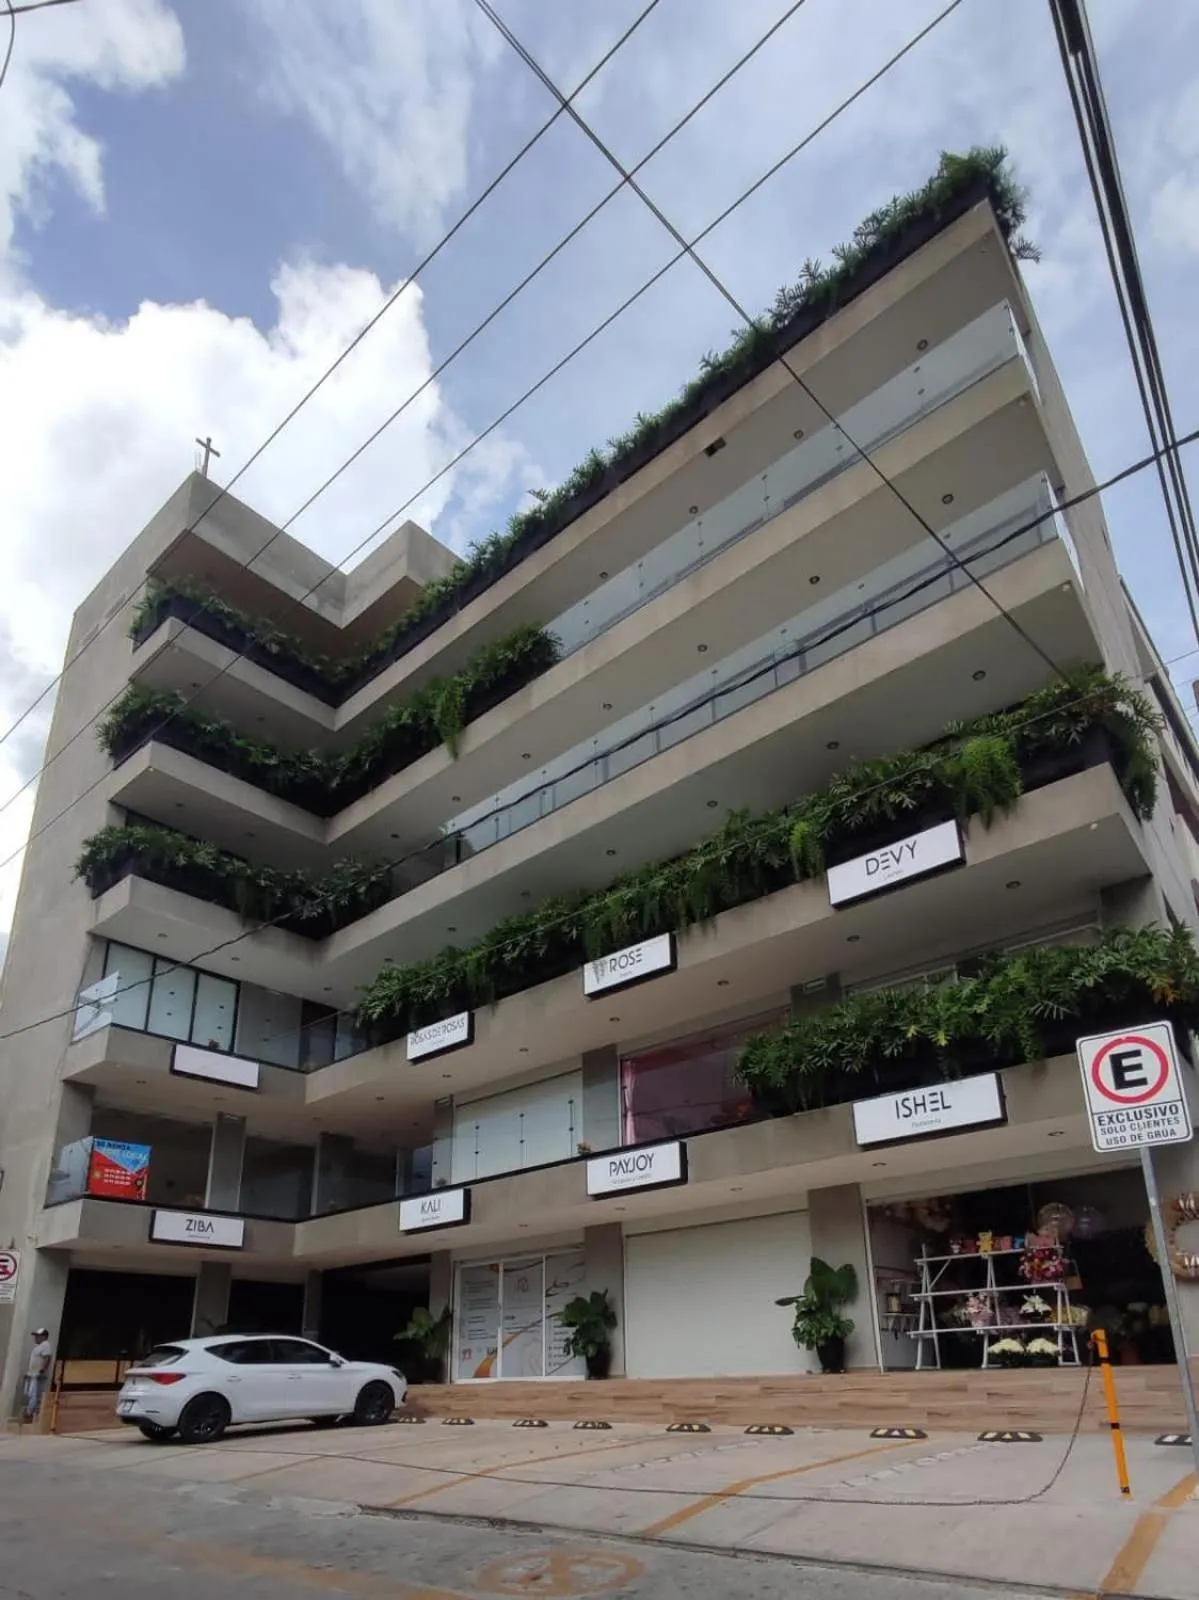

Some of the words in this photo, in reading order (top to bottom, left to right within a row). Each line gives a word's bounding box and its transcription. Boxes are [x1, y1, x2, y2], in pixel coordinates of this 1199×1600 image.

[865, 840, 917, 876] DEVY
[609, 947, 643, 973] ROSE
[1110, 1048, 1149, 1091] E
[895, 1090, 952, 1120] ISHEL
[1097, 1103, 1179, 1126] EXCLUSIVO
[1100, 1125, 1127, 1136] SOLO
[1130, 1116, 1180, 1132] CLIENTES
[1105, 1135, 1127, 1146] USO
[1130, 1132, 1145, 1143] DE
[609, 1152, 655, 1177] PAYJOY
[420, 1198, 441, 1215] KALI
[185, 1218, 215, 1233] ZIBA
